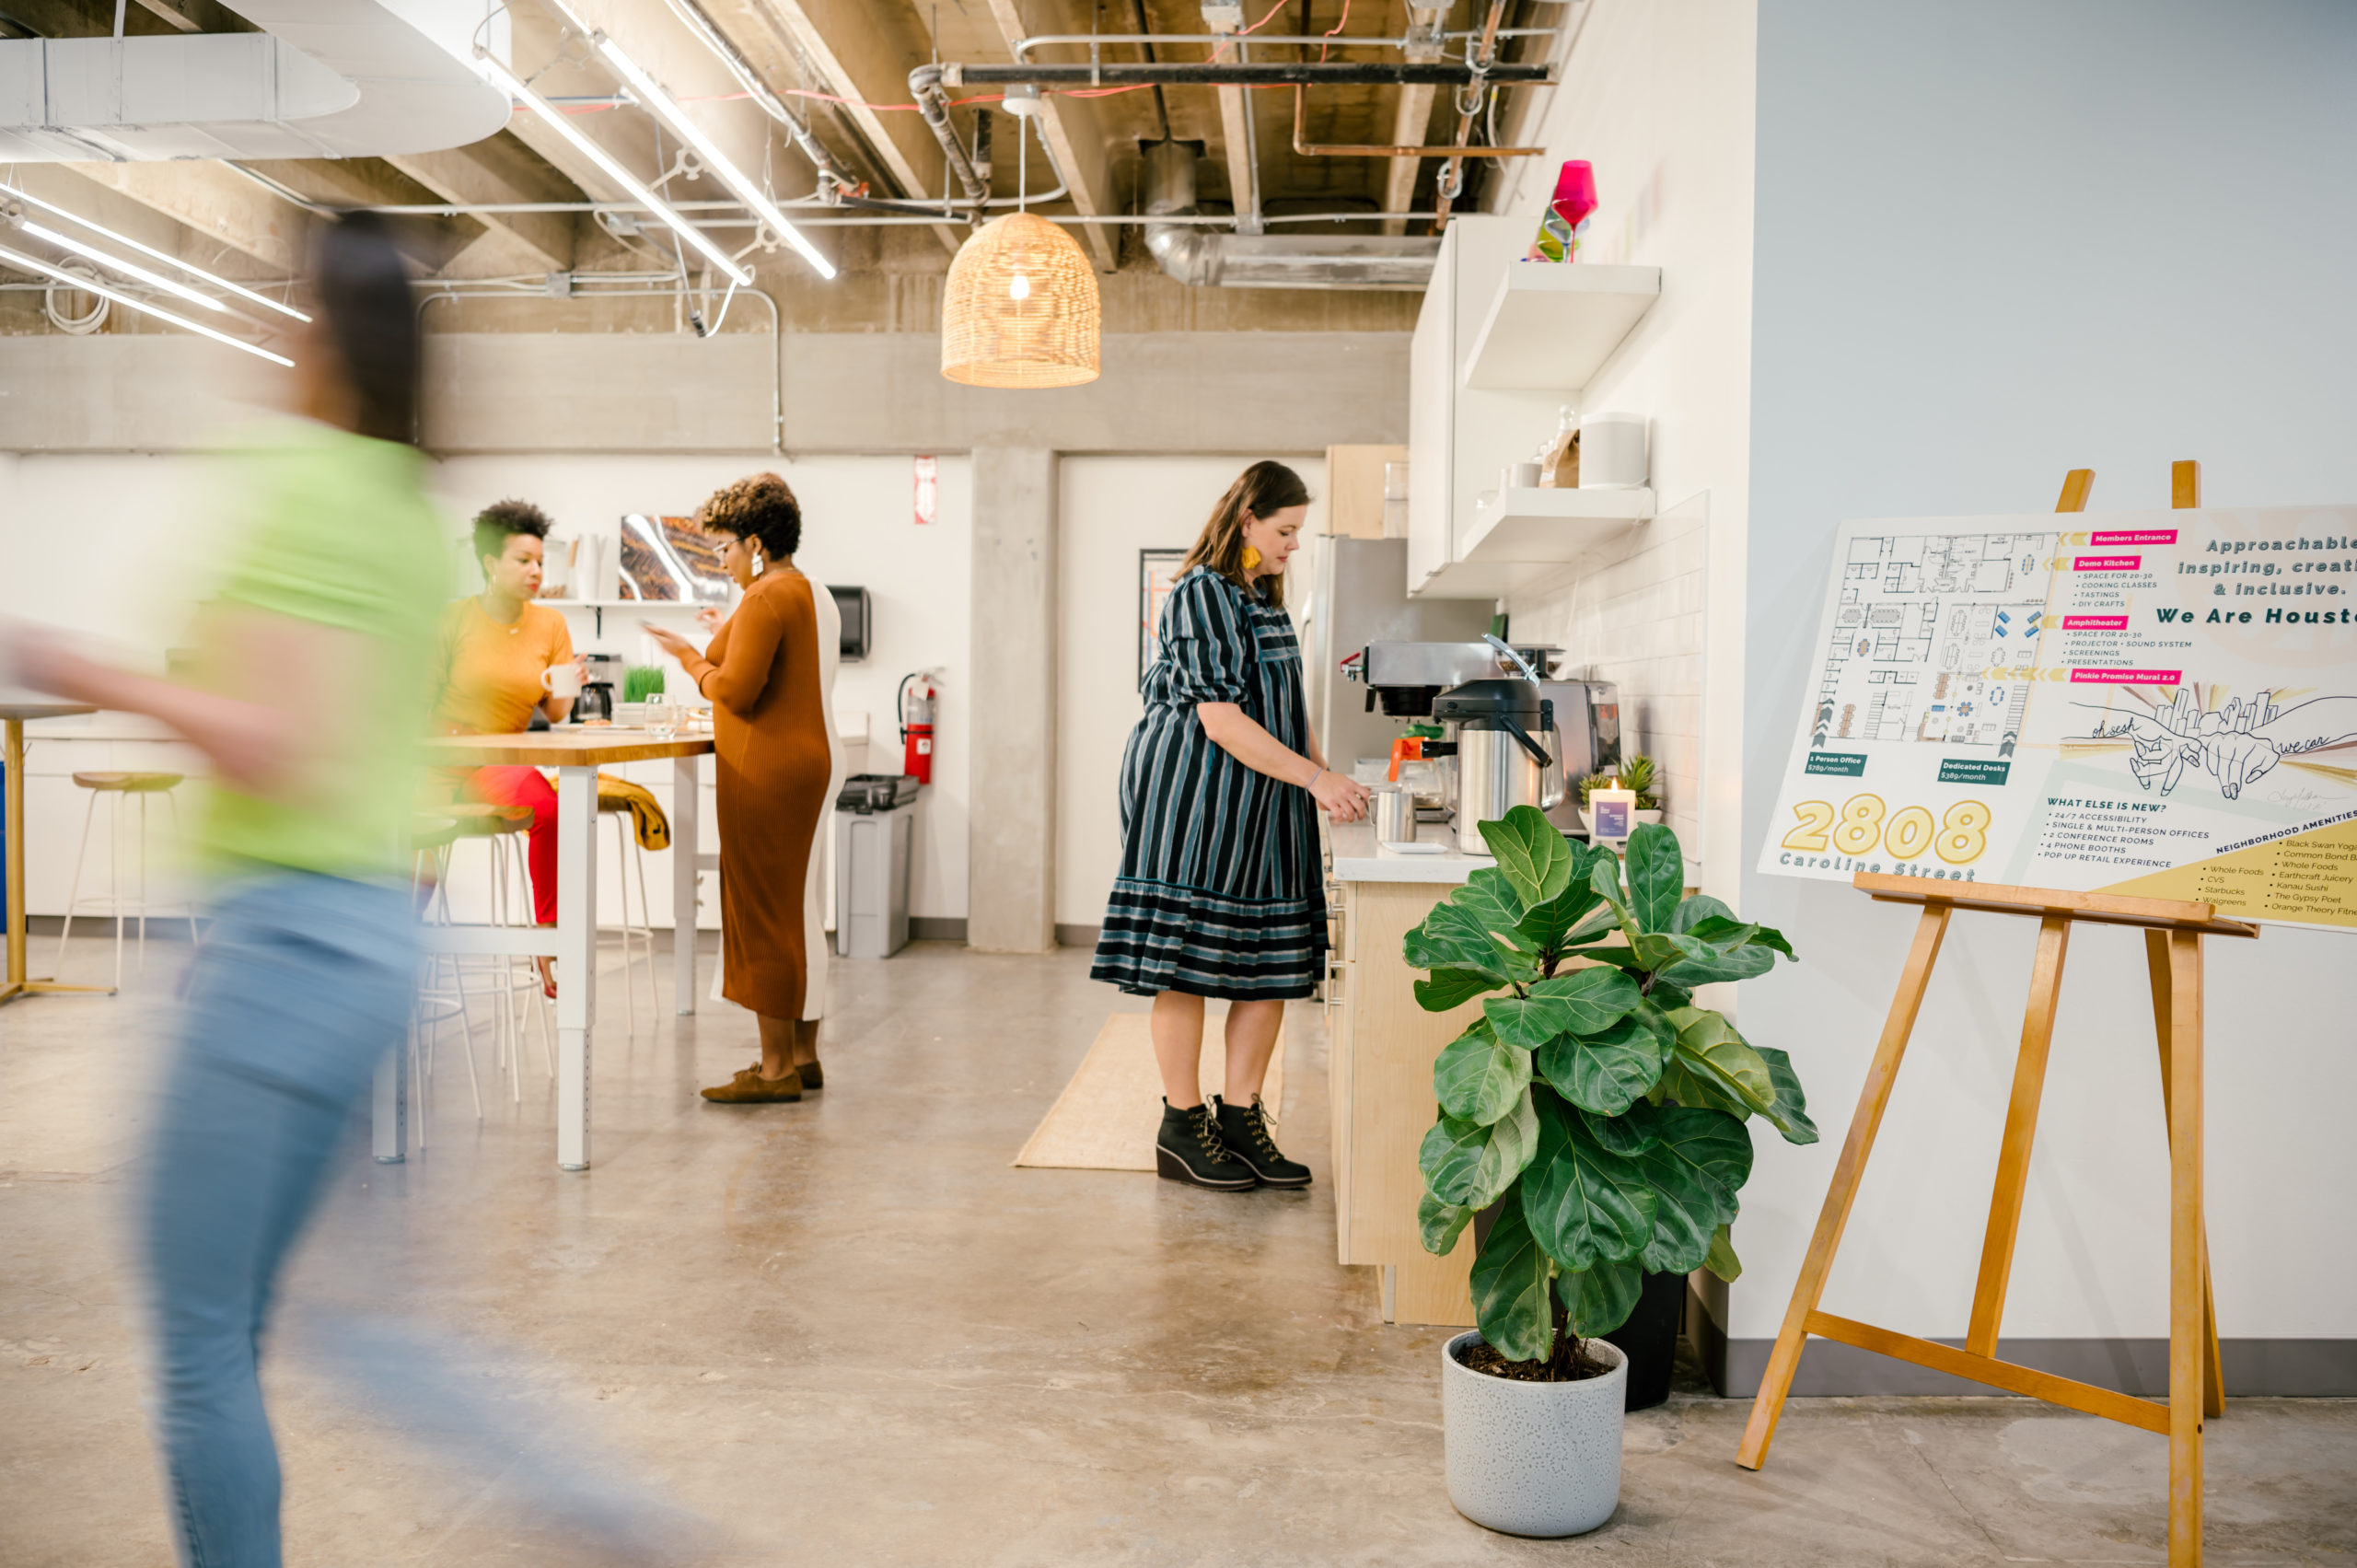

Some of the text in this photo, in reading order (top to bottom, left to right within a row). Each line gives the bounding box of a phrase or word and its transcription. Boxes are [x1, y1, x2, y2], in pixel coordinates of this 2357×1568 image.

[2178, 561, 2282, 576] inspiring,
[2213, 582, 2346, 596] & inclusive.
[2156, 609, 2357, 623] We Are Houst
[2068, 620, 2122, 628] Amphitheater
[2278, 741, 2304, 753] we
[1807, 764, 1849, 772] $789/month
[2048, 797, 2166, 812] WHAT ELSE IS NEW?
[2079, 813, 2147, 823] ACCESSIBILITY
[1781, 793, 1991, 865] 2808
[2052, 821, 2084, 830] SINGLE
[2096, 824, 2166, 836] MULTI-PERSON
[2169, 830, 2210, 839] OFFICES
[2216, 810, 2357, 854] NEIGHBORHOOD AMENITIES
[2057, 832, 2118, 842] CONFERENCE
[2120, 837, 2154, 845] ROOMS
[2286, 840, 2309, 848] Black
[2088, 845, 2126, 854] BOOTHS
[2079, 854, 2110, 864] RETAIL
[2114, 857, 2171, 867] EXPERIENCE
[2284, 851, 2323, 859] Common
[2325, 853, 2348, 861] Bond
[1780, 852, 1975, 882] Caroline Street
[2211, 865, 2264, 876] Whole Foods
[2282, 861, 2339, 871] Whole Foods
[2279, 872, 2354, 884] Earthcraft Juicery
[2205, 887, 2245, 895] Starbucks
[2202, 897, 2247, 906] Walgreens
[2293, 894, 2319, 903] Gypsy
[2321, 896, 2341, 904] Poet
[2271, 903, 2303, 912] Orange
[2305, 905, 2335, 915] Theory
